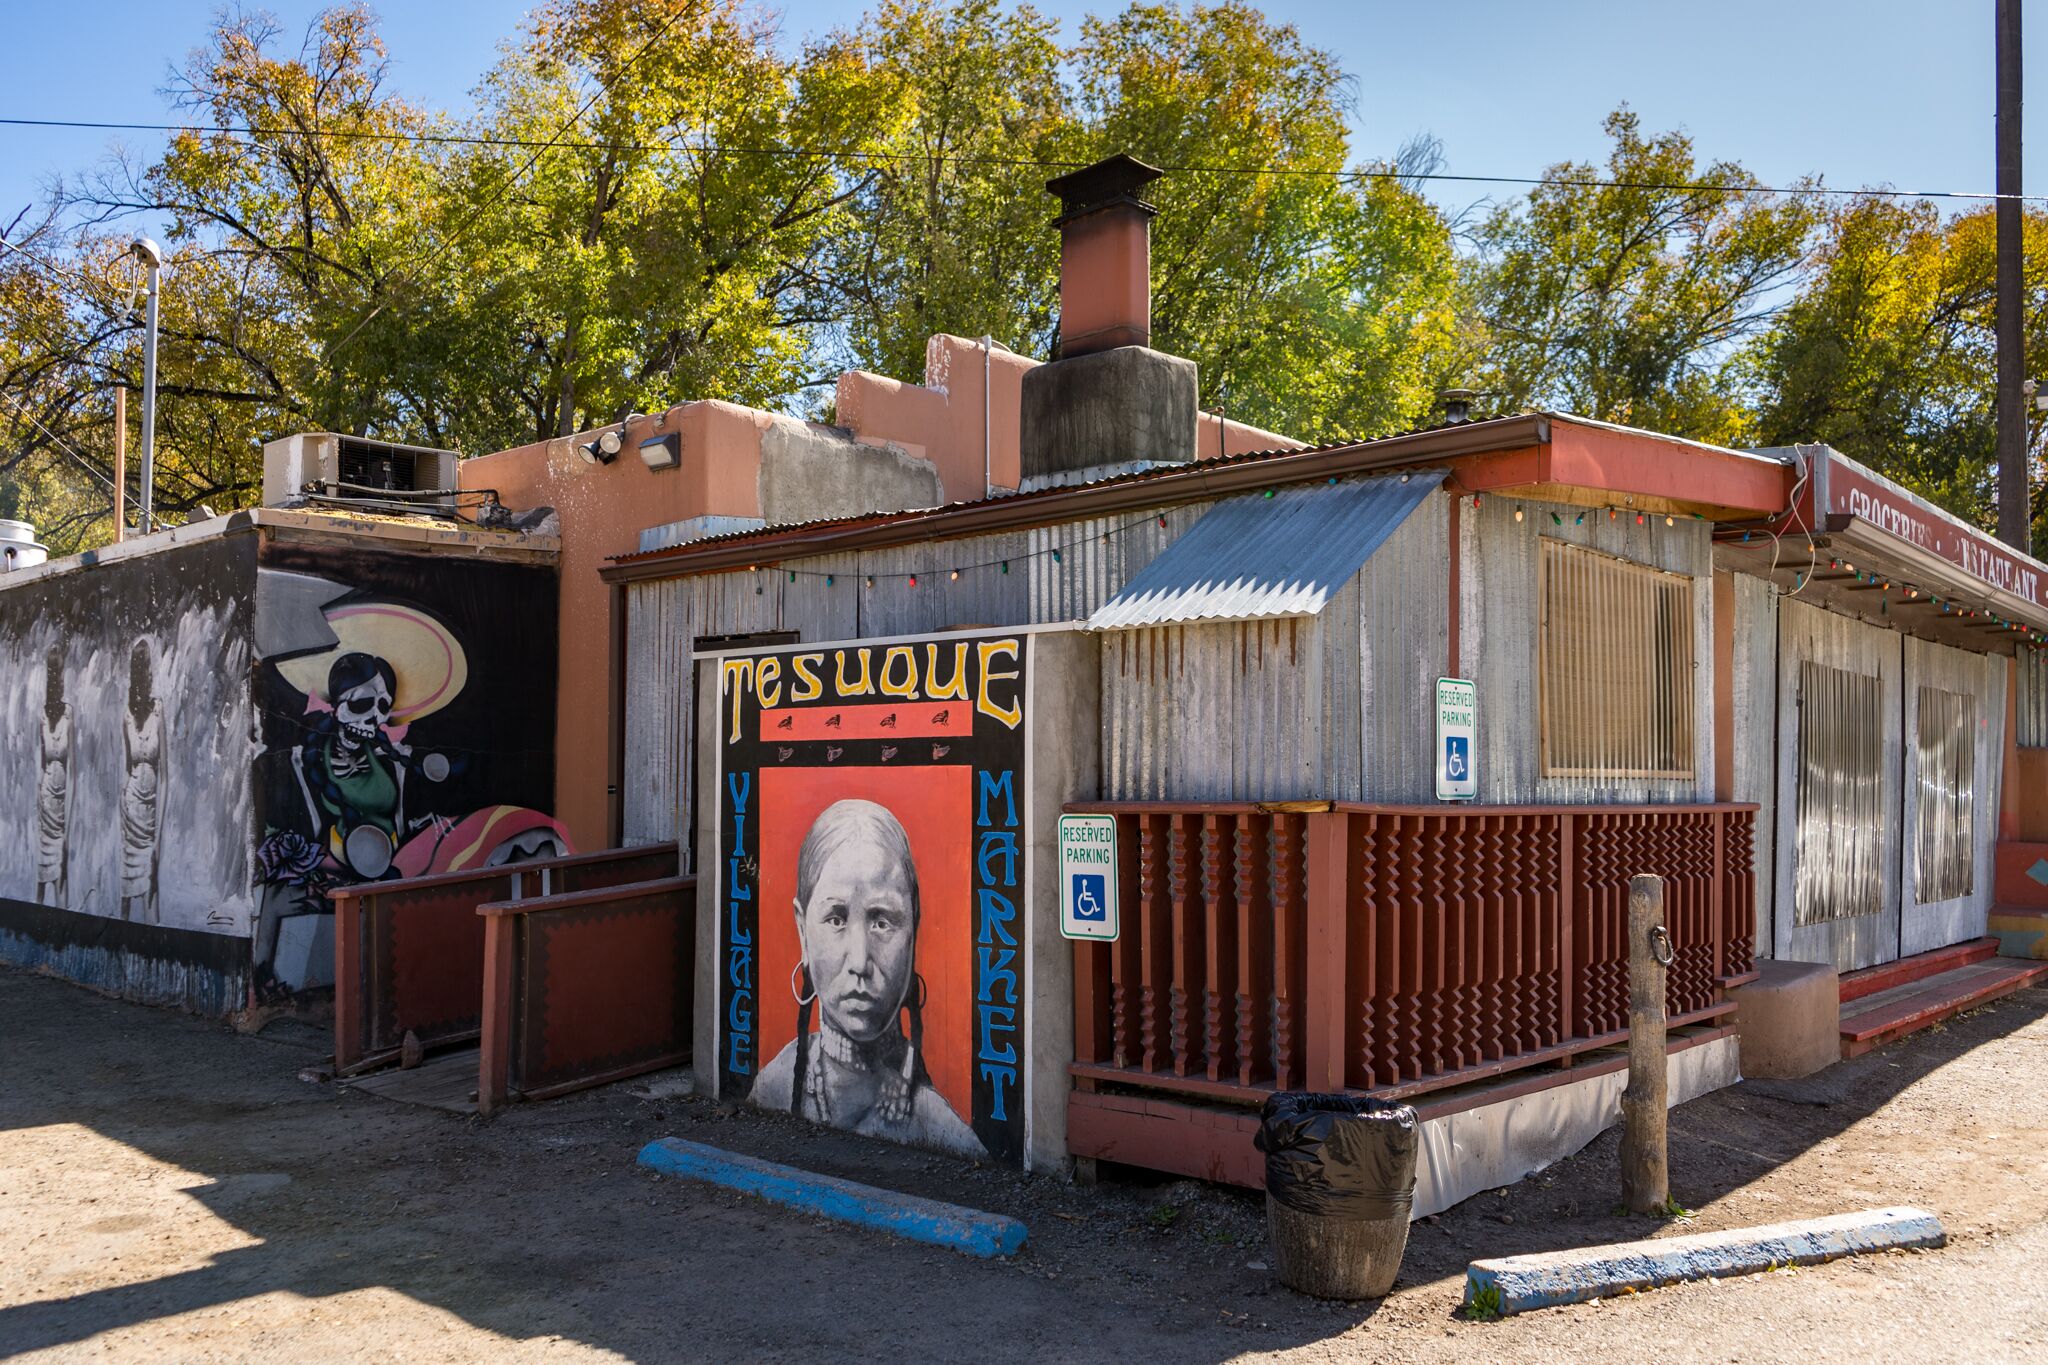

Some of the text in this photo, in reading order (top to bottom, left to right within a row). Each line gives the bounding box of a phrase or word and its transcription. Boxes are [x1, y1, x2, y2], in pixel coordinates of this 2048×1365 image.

[1440, 690, 1473, 707] RESERVED
[1442, 711, 1472, 727] PARKING
[1063, 827, 1112, 842] RESERVED
[1066, 848, 1110, 864] PARKING
[728, 772, 750, 1074] VILLAGE
[977, 770, 1019, 1121] MARKET
